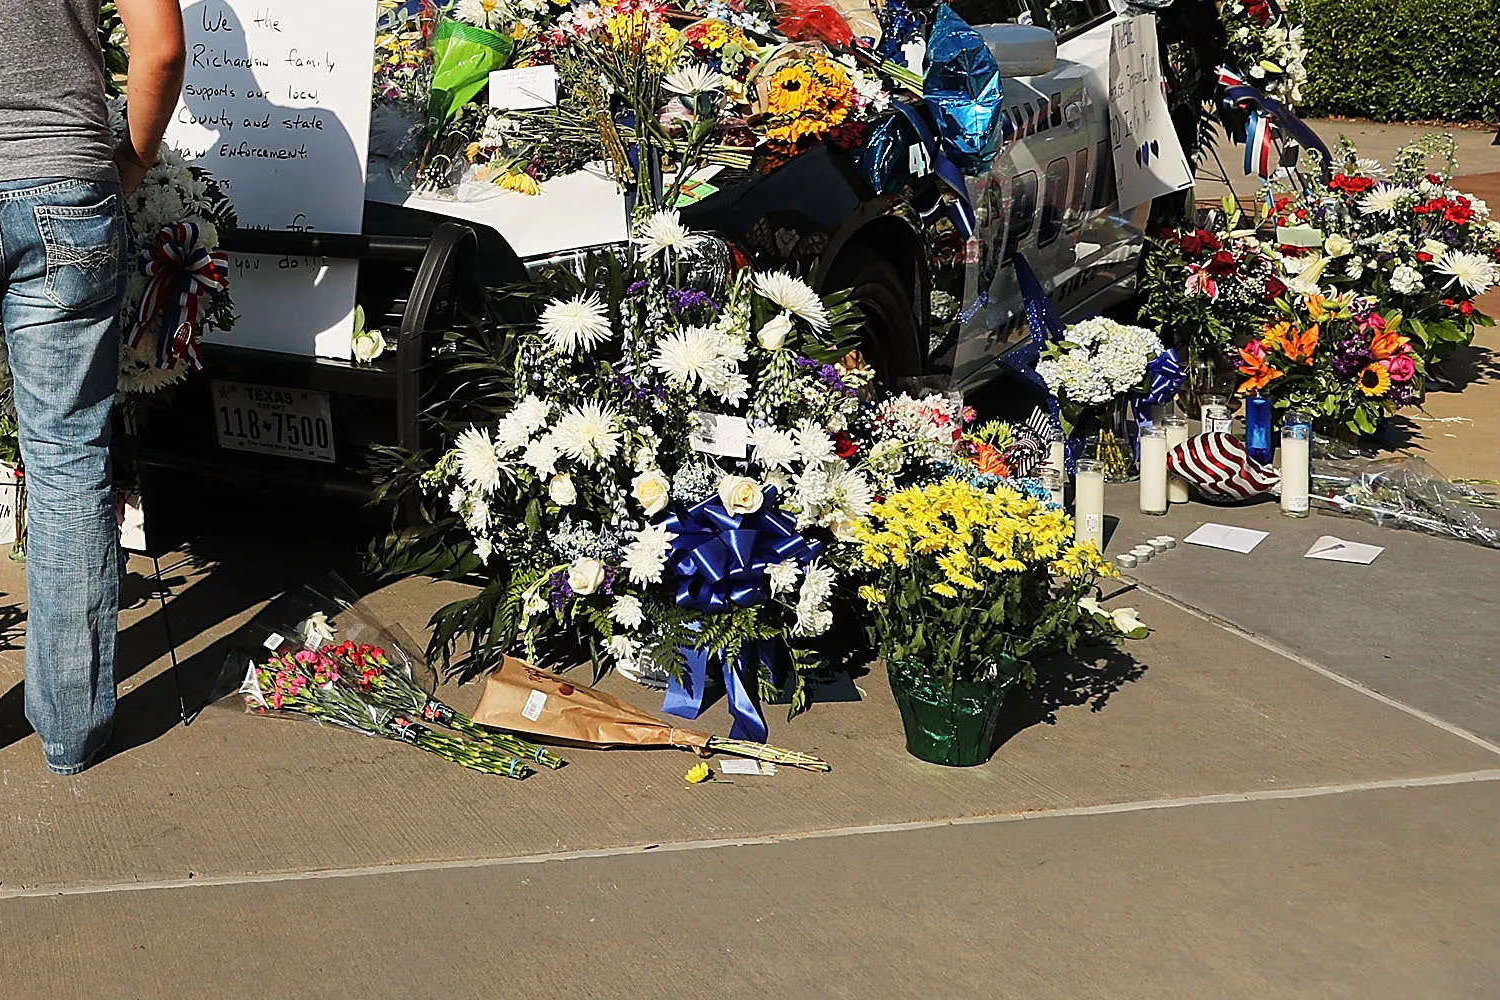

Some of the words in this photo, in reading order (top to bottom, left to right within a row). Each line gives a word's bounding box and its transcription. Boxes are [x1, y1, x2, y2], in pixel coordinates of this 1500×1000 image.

[202, 5, 233, 32] We
[254, 8, 282, 32] the
[284, 48, 337, 73] family
[246, 87, 270, 100] our
[177, 106, 234, 131] County
[243, 113, 271, 130] and
[282, 114, 325, 131] state
[219, 141, 308, 160] Enforcement.
[235, 256, 260, 278] you
[245, 386, 294, 406] TEXAS
